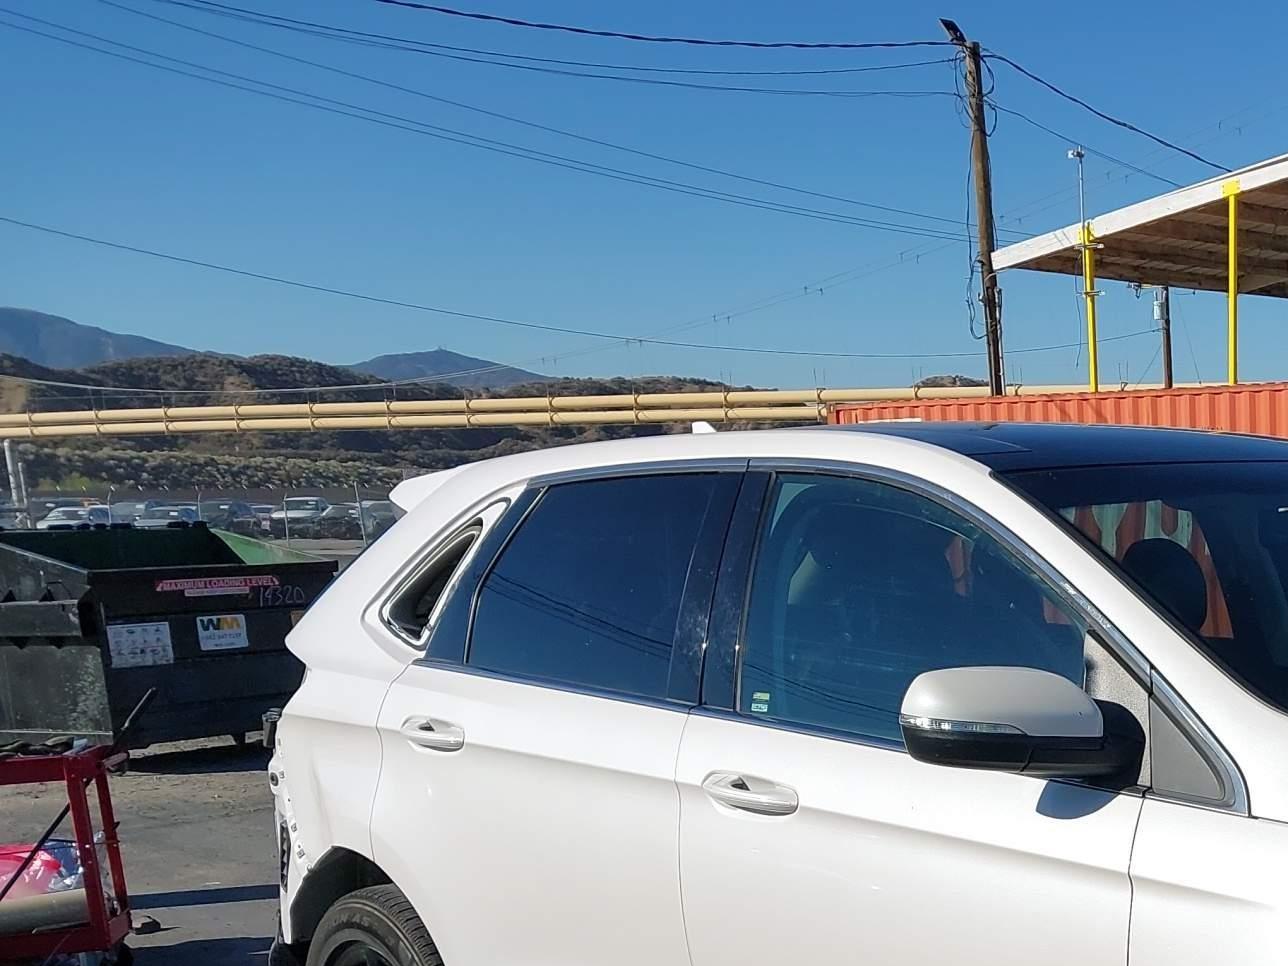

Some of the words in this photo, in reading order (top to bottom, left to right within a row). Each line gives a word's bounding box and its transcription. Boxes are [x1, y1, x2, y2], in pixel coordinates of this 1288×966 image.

[163, 580, 205, 591] MAXIMUM
[206, 578, 246, 588] LOADING
[247, 576, 273, 586] LEVEL
[199, 617, 241, 631] WM
